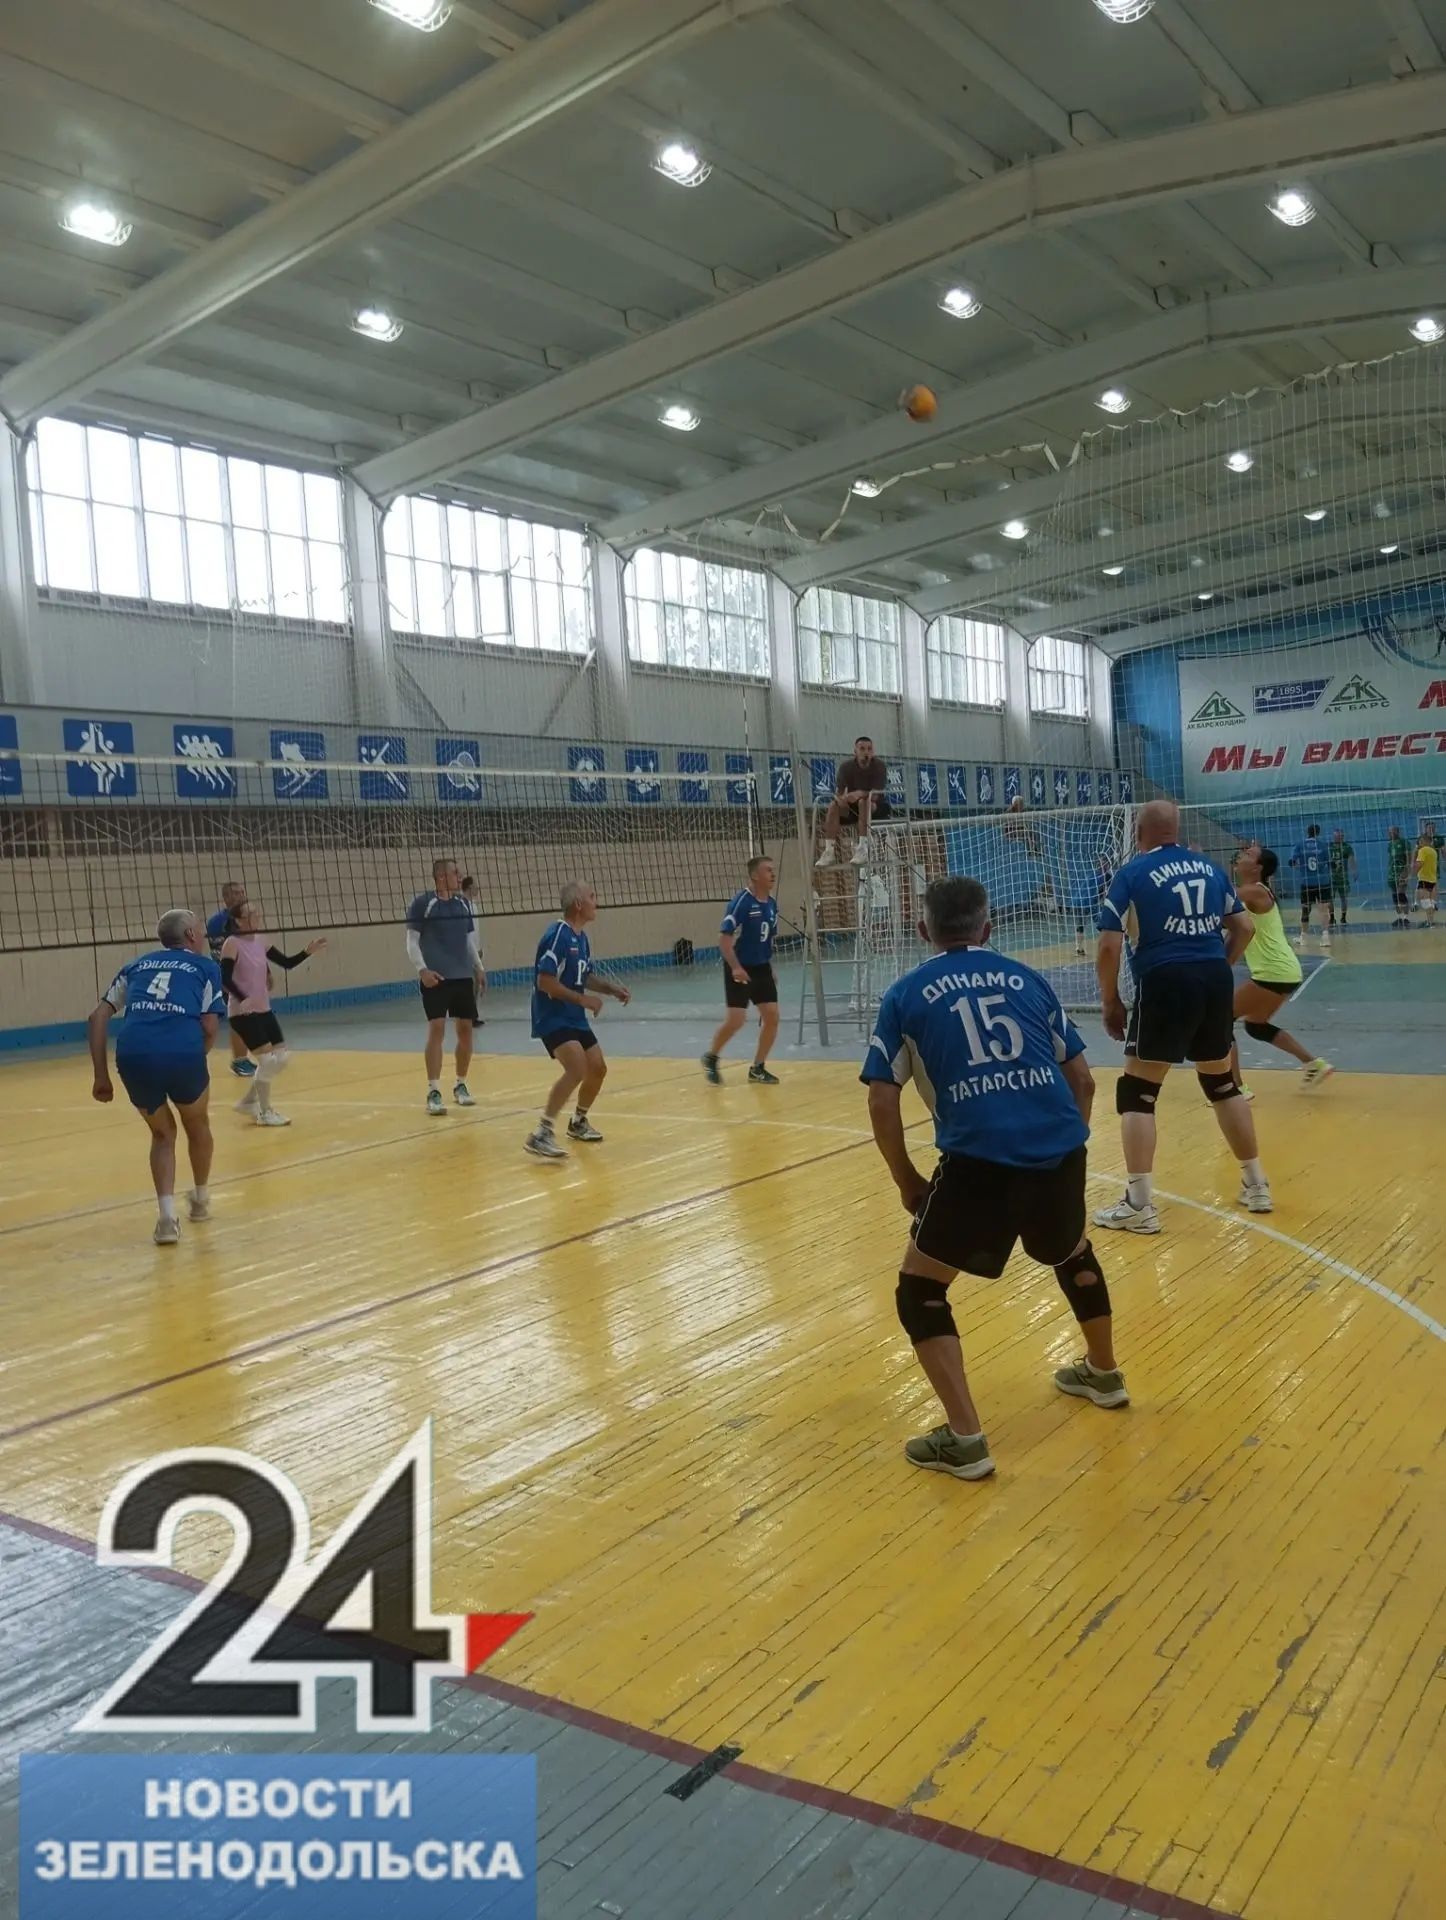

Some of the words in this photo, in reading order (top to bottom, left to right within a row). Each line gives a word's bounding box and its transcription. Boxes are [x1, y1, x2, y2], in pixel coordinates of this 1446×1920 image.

[1323, 706, 1342, 714] АК
[1348, 701, 1390, 712] БАРС
[1149, 860, 1214, 888] ДИНАМО
[1308, 856, 1317, 871] 6
[1171, 878, 1206, 916] 17
[760, 921, 770, 942] 9
[1163, 913, 1221, 936] КАЗАНЬ
[146, 971, 172, 1000] 4
[922, 971, 1024, 1004] ДИНАМО
[949, 993, 1024, 1066] 15
[948, 1066, 1055, 1103] ТАТАРСТАН
